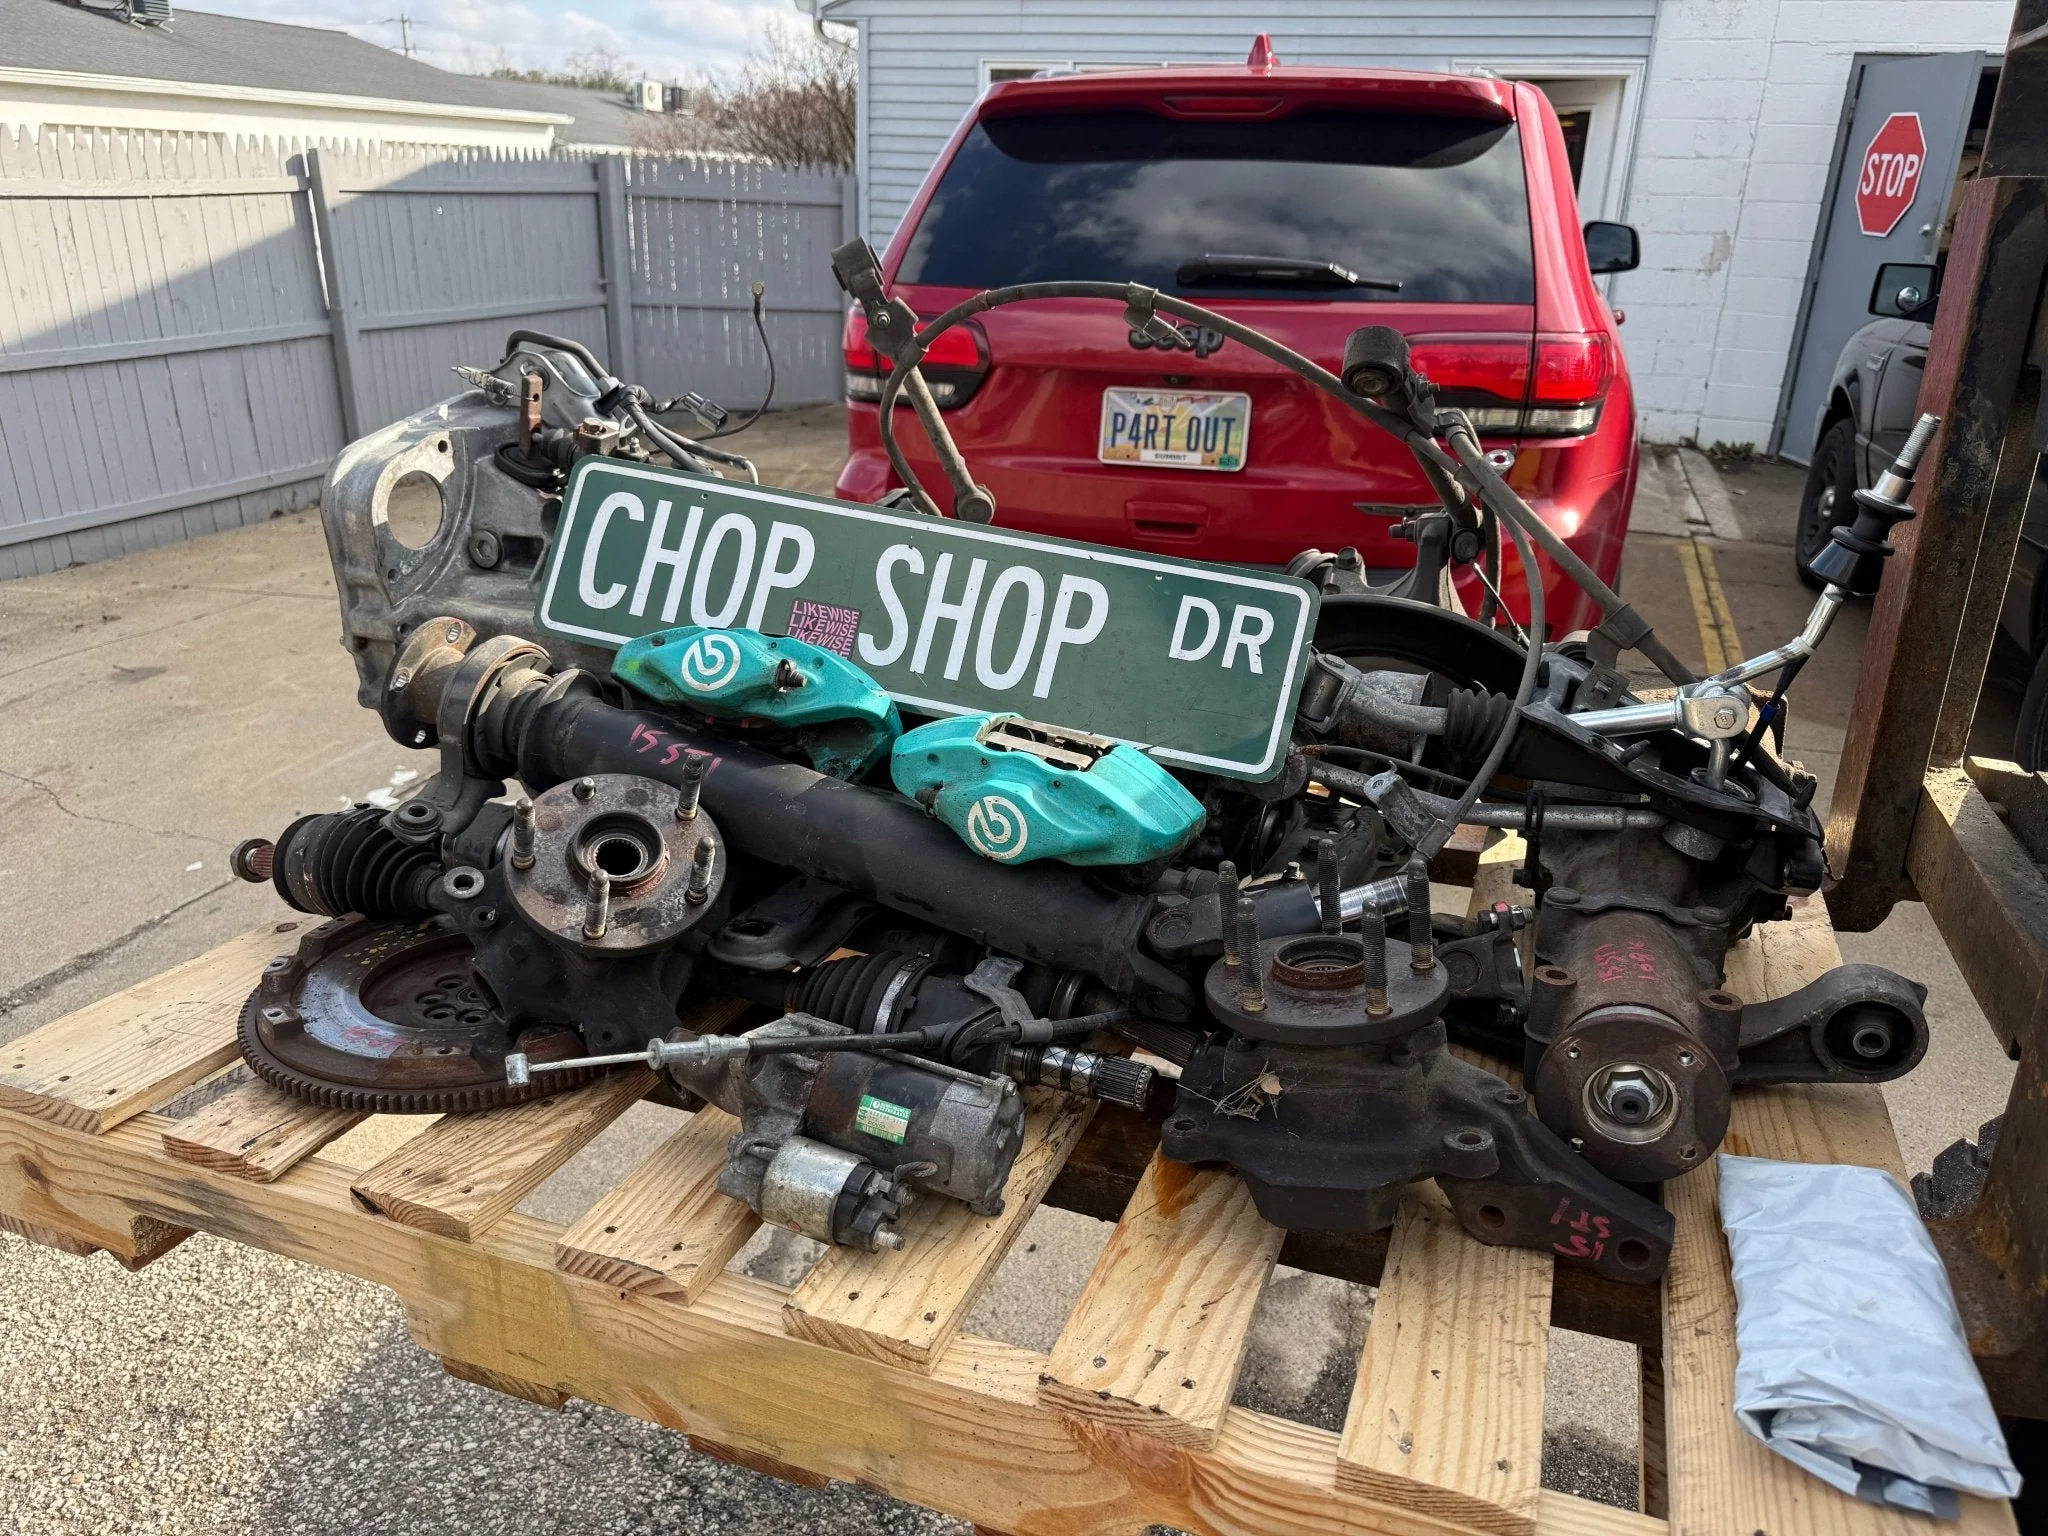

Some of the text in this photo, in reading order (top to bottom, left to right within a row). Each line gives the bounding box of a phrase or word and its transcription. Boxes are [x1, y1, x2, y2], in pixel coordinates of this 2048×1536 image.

[1862, 153, 1919, 198] STOP
[1111, 412, 1236, 454] P4RT OUT
[579, 491, 1275, 699] CHOP SHOP DR
[793, 600, 859, 625] LIKEWISE
[790, 614, 856, 638] LIKEWISE
